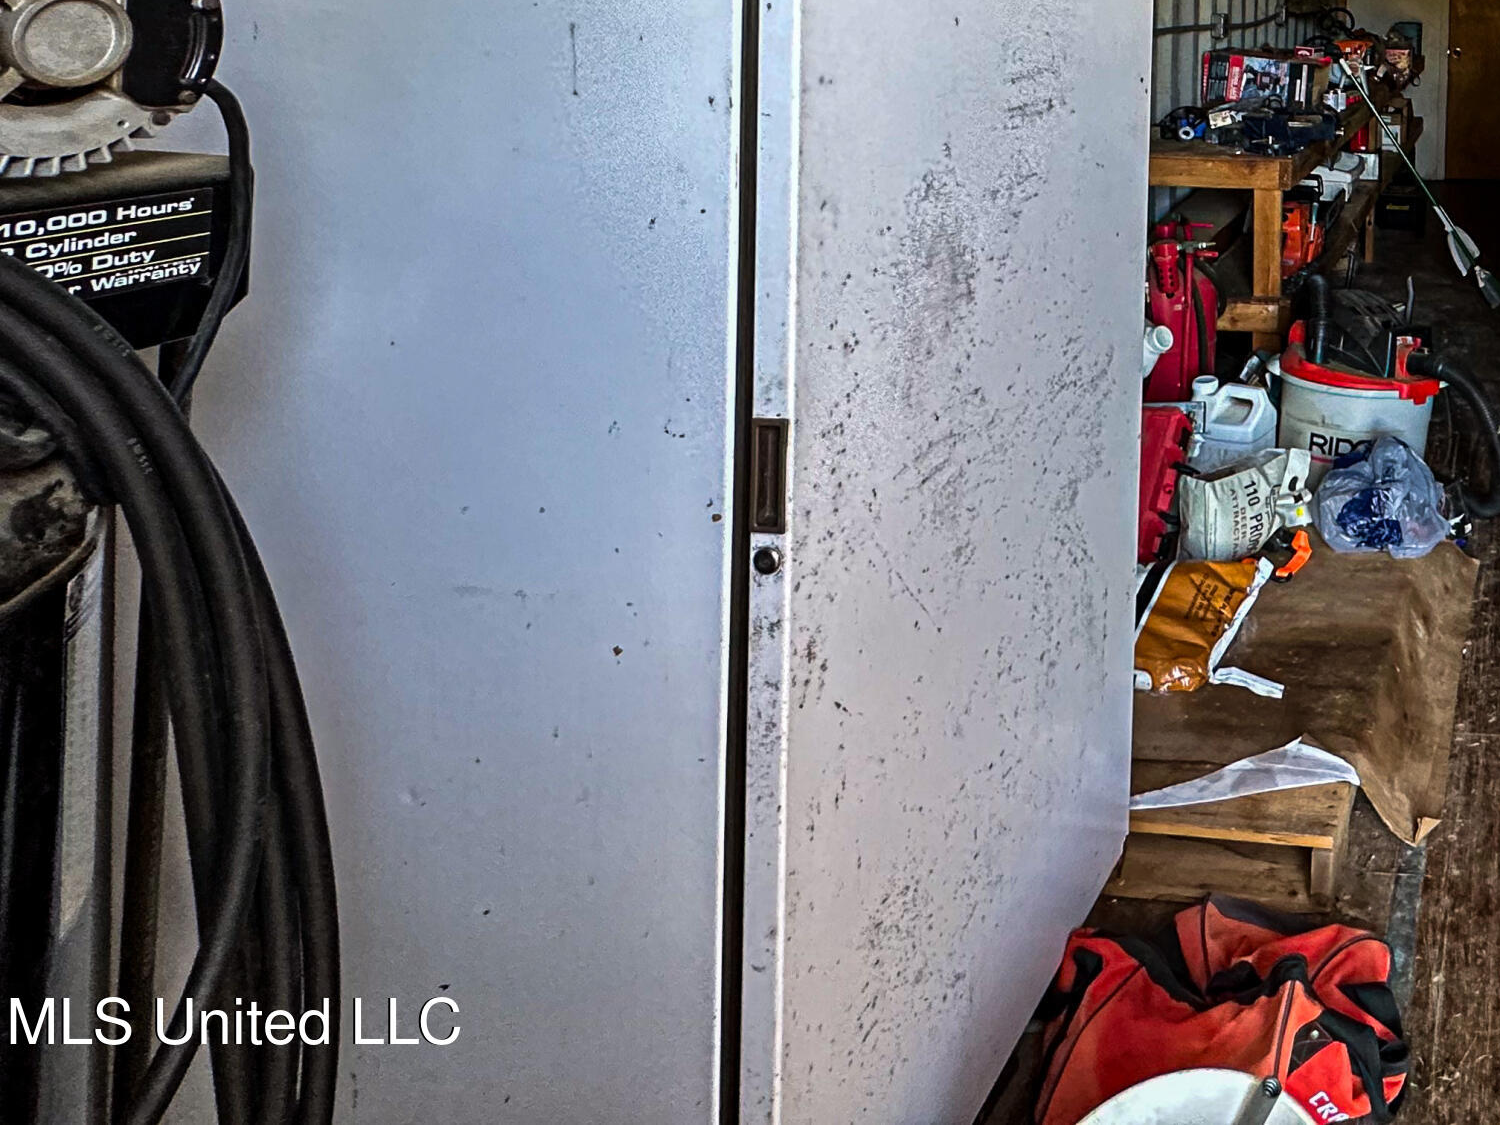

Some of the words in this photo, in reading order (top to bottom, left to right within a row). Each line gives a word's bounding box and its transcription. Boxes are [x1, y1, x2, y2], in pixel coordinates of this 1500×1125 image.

[25, 231, 137, 259] Cylinder
[92, 250, 156, 271] Duty
[90, 262, 201, 292] Warranty
[1244, 480, 1260, 507] 110
